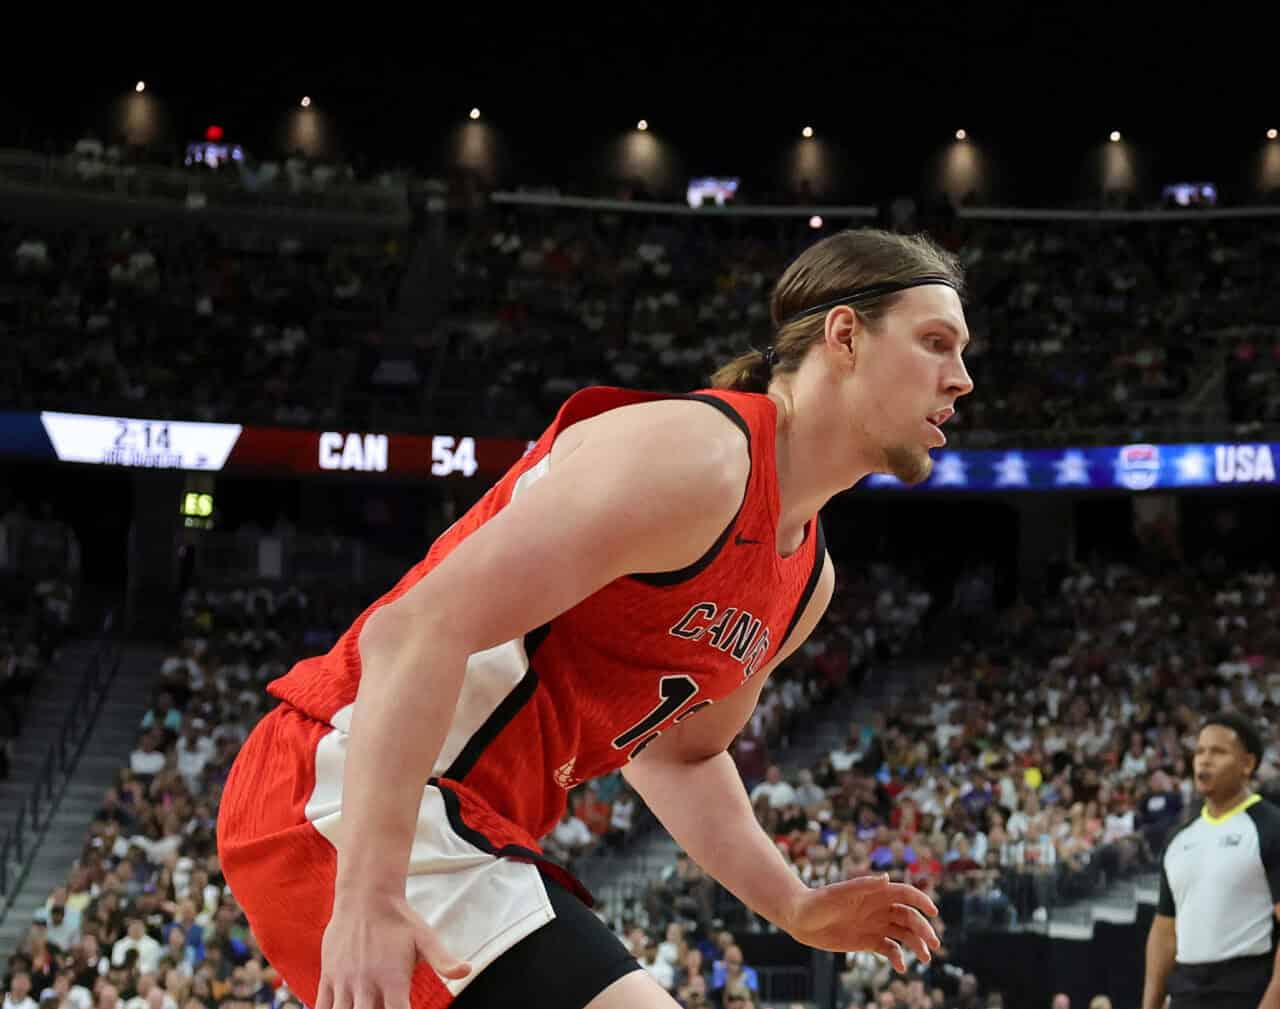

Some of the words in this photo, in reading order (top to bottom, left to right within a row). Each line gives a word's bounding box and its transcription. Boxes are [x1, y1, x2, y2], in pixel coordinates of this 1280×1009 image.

[319, 431, 388, 472] CAN
[430, 435, 478, 477] 54
[1214, 445, 1276, 483] USA
